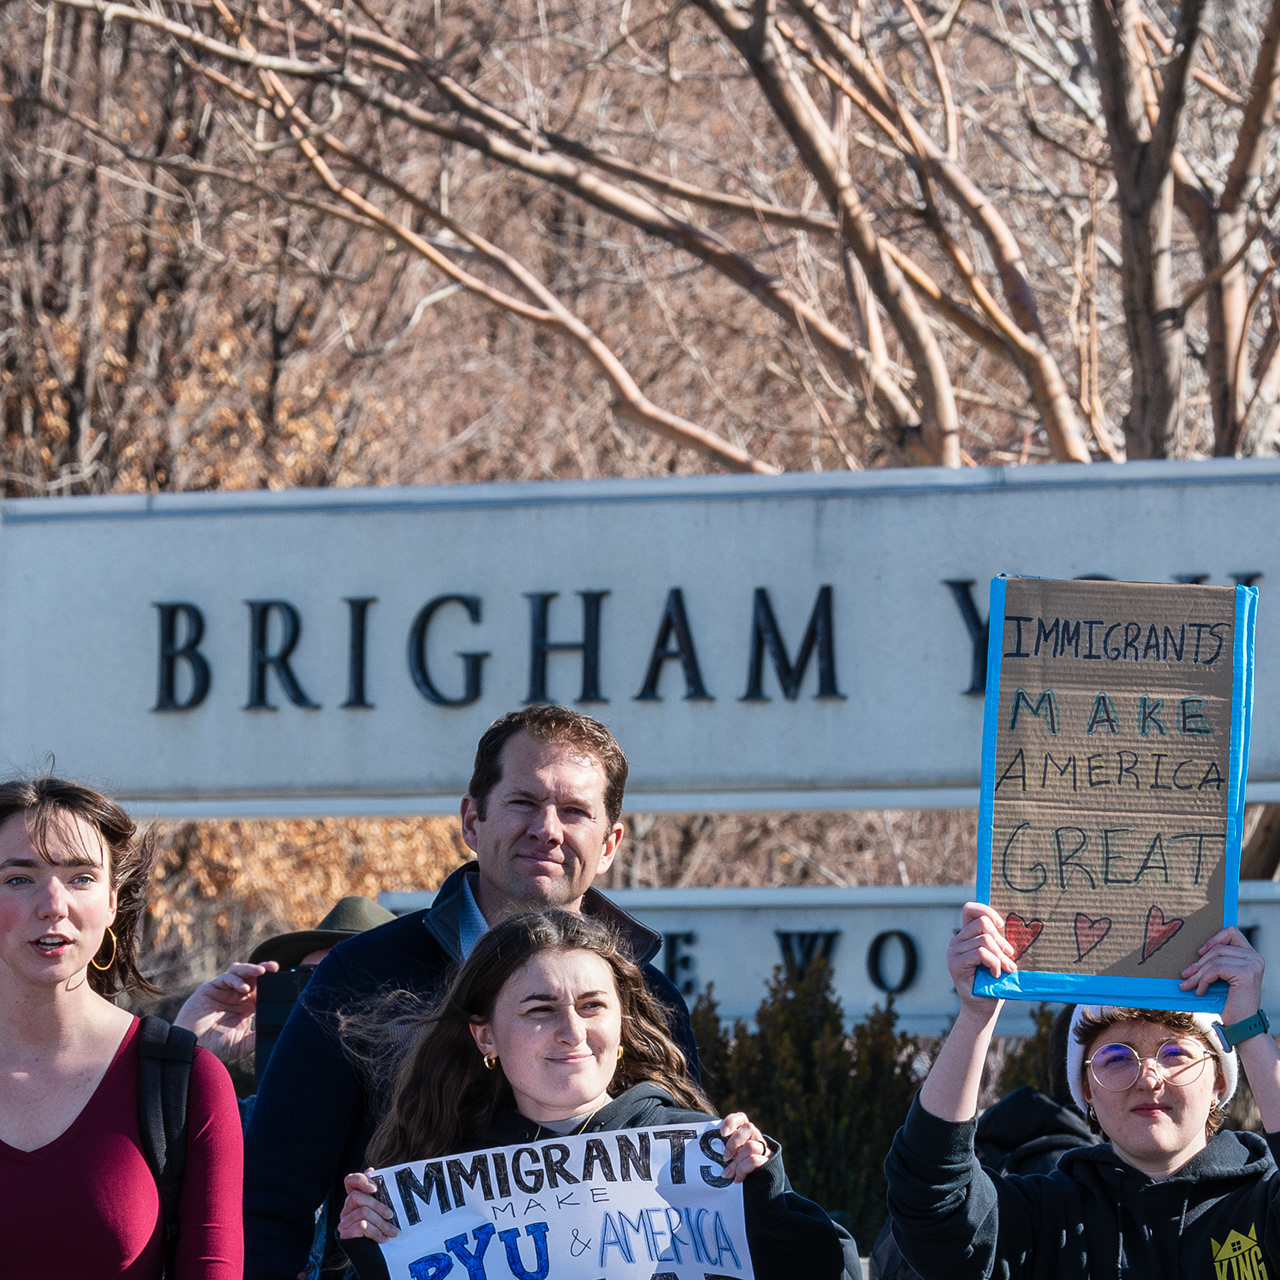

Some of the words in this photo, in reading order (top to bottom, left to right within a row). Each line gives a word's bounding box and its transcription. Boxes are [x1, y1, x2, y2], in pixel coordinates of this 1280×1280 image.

[151, 584, 848, 713] BRIGHAM
[1003, 615, 1232, 665] IMMIGRANTS
[1010, 687, 1213, 736] MAKE
[995, 748, 1225, 792] AMERICA
[1002, 823, 1225, 894] GREAT
[492, 1186, 611, 1221] MAKE
[570, 1228, 592, 1258] &
[599, 1206, 743, 1269] AMERICA
